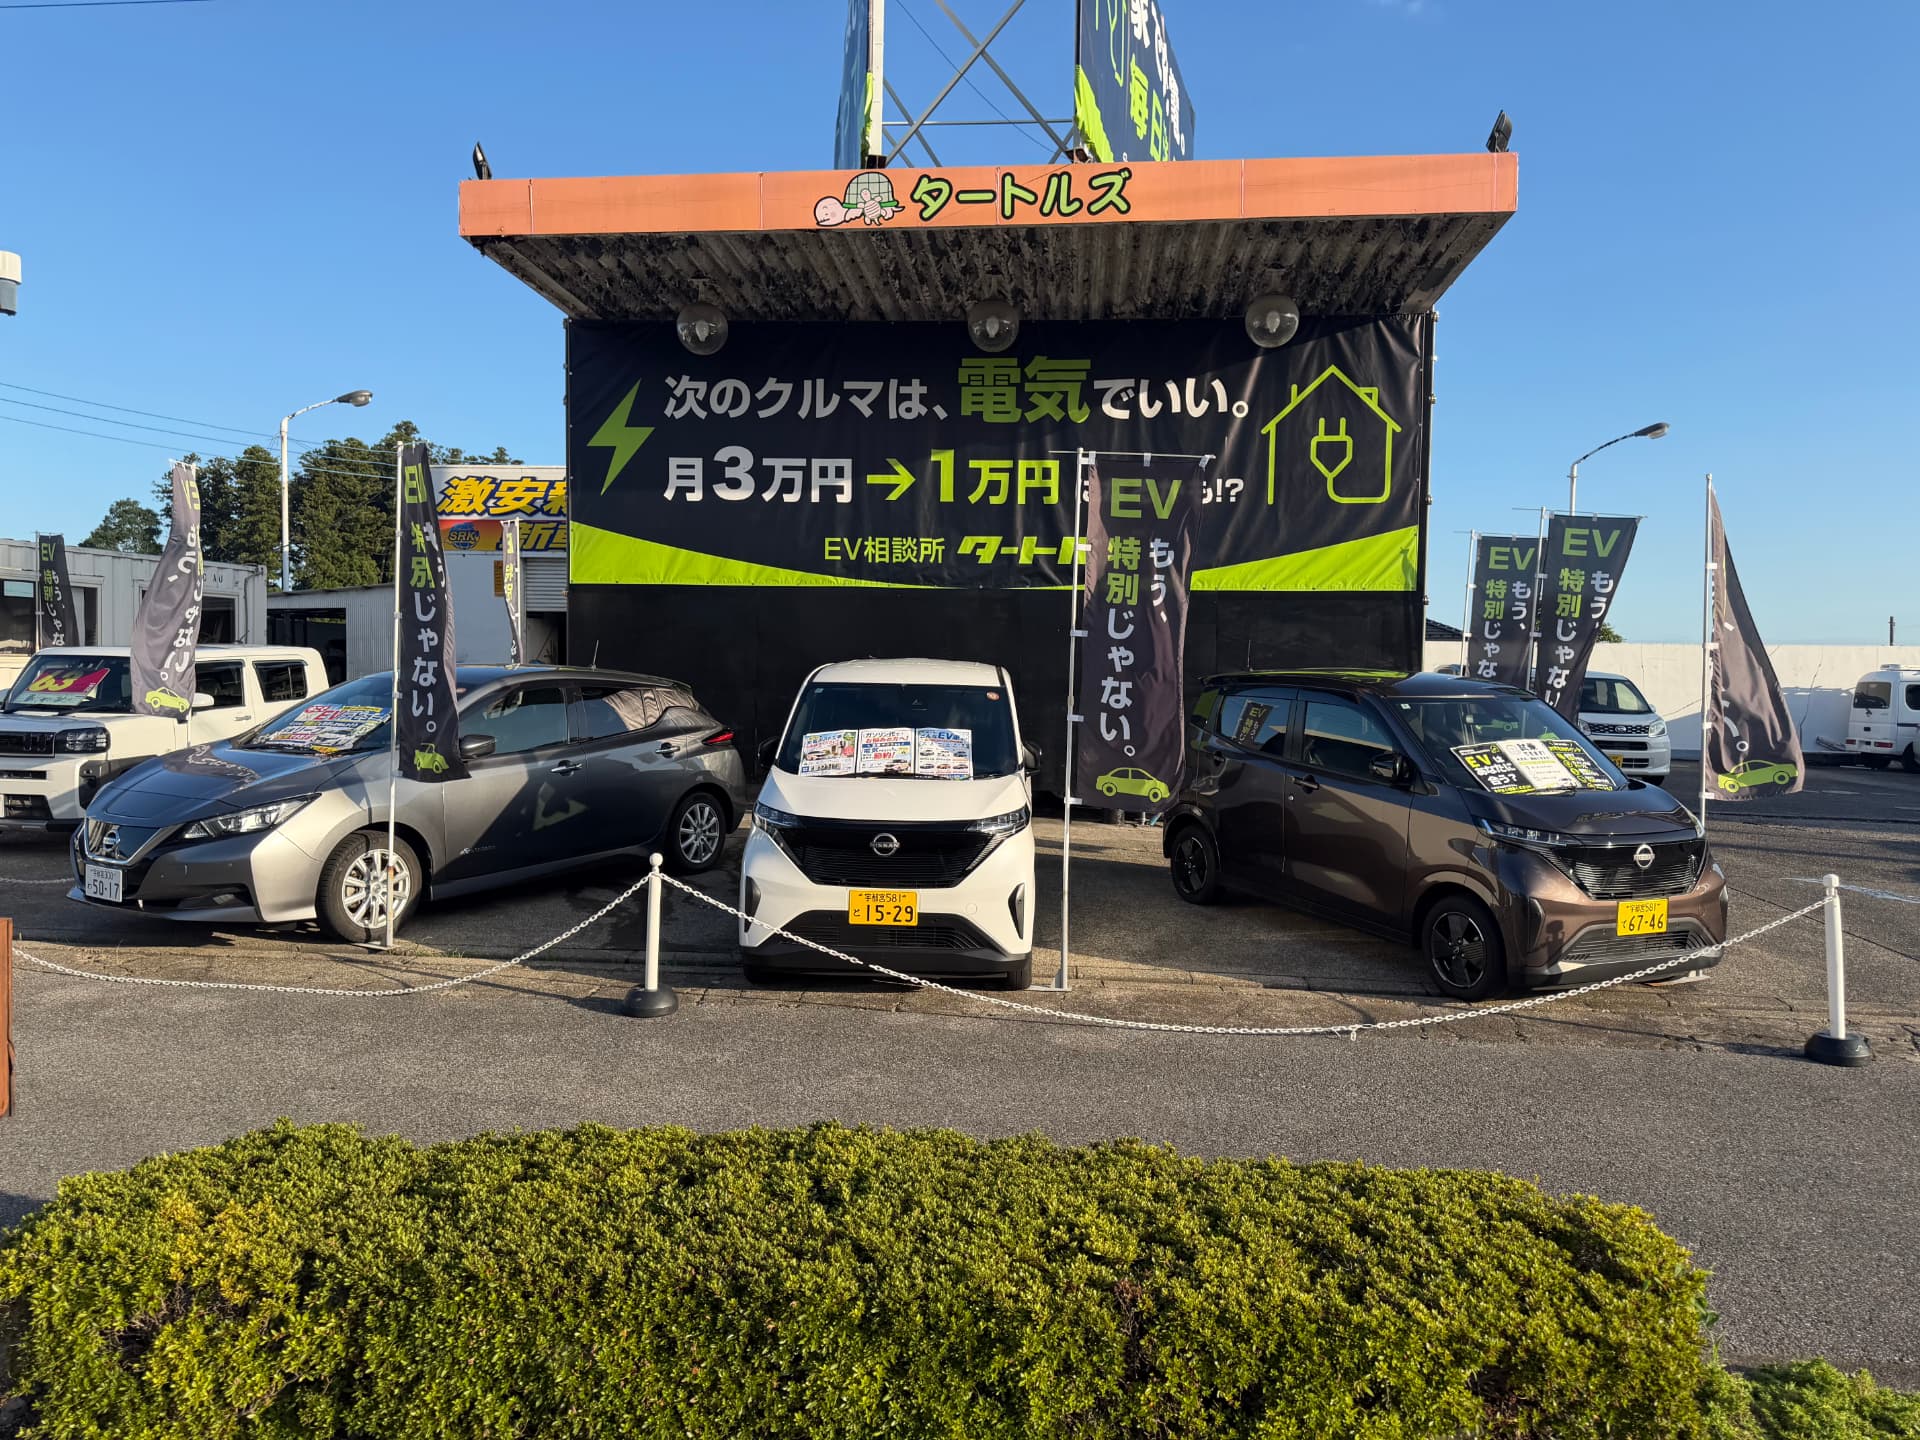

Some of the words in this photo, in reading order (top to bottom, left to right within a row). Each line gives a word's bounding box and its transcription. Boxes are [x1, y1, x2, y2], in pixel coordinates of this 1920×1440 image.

[911, 169, 1132, 220] タートルズ
[663, 357, 1249, 423] 次のクルマは、電気でいい。
[663, 446, 853, 503] 月3万円
[929, 449, 1059, 504] 1万円
[1111, 478, 1182, 519] EV
[42, 543, 56, 561] EV
[449, 531, 475, 541] SRK
[824, 537, 945, 563] EV相談所
[1489, 547, 1535, 570] EV
[1562, 528, 1620, 557] EV
[1150, 538, 1175, 623] もう、
[1590, 570, 1614, 628] もう、
[410, 521, 436, 734] 特別じゃない。
[1477, 579, 1507, 678] 特別じゃな
[1512, 581, 1531, 630] もう、
[1101, 536, 1142, 757] 特別じゃない。
[866, 904, 914, 922] 15-29
[1628, 913, 1664, 932] 67-46
